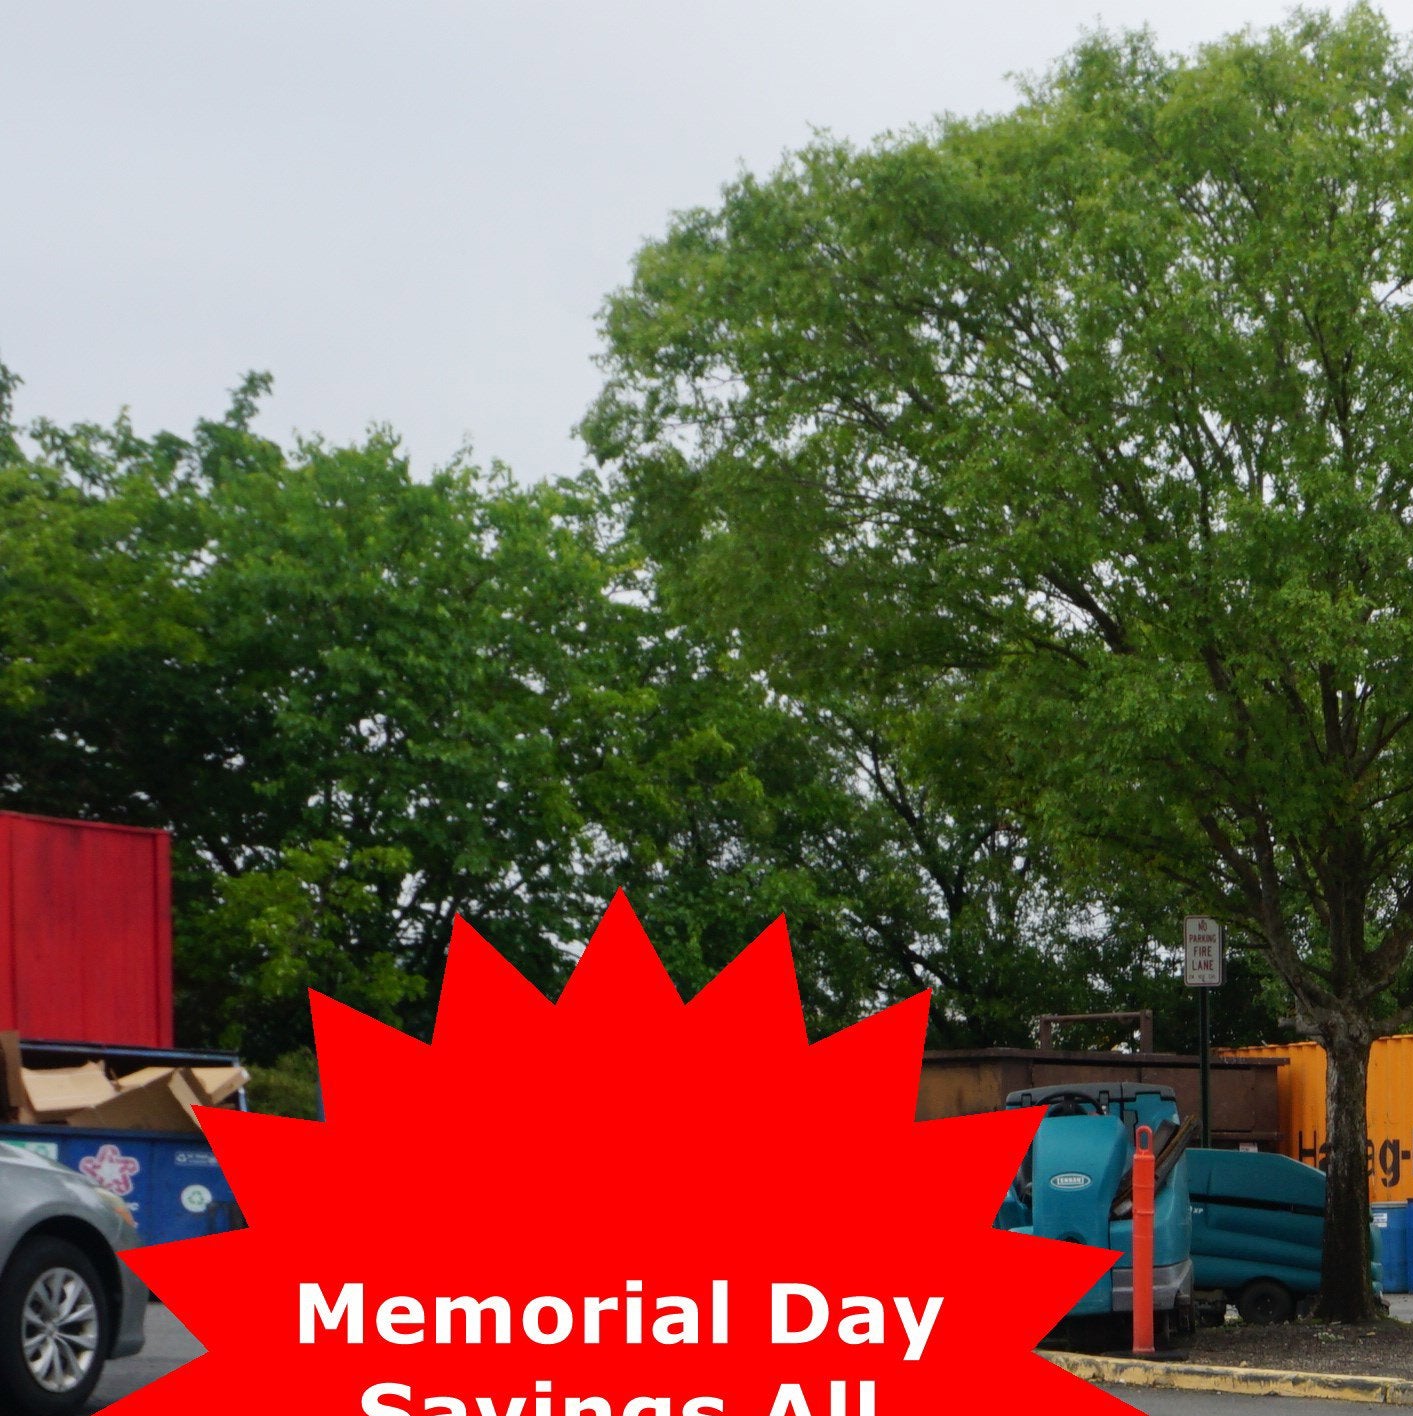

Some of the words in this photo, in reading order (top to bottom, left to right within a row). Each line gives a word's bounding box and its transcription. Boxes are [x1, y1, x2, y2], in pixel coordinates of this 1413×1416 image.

[1198, 921, 1207, 931] NO
[1189, 934, 1216, 943] PARKING
[1193, 946, 1212, 957] FIRE
[1192, 960, 1214, 971] LANE
